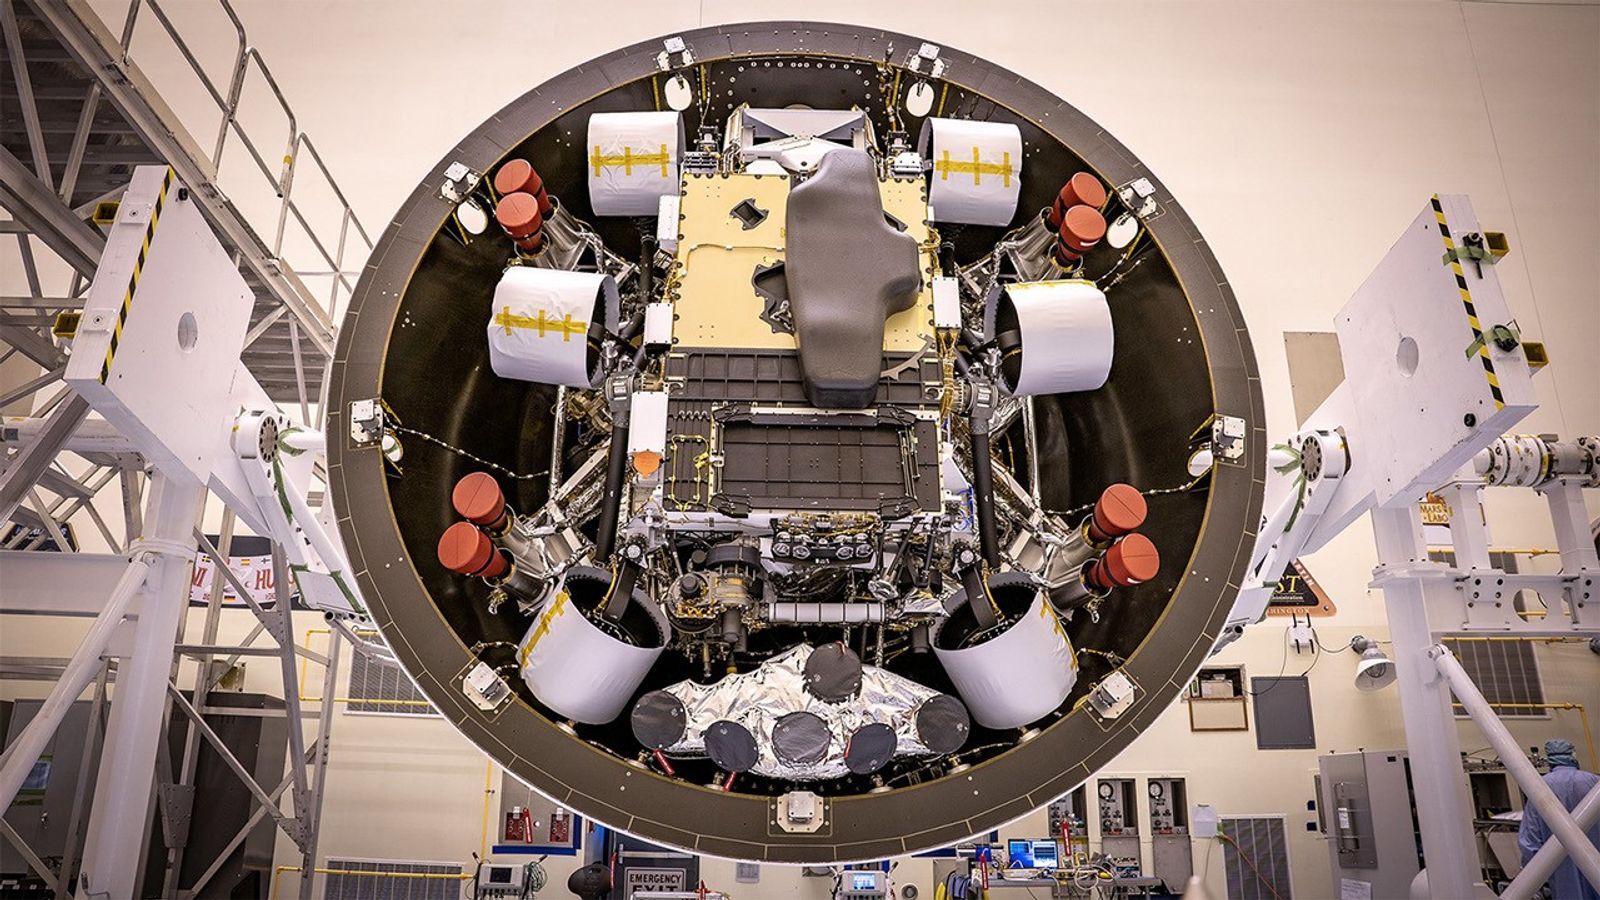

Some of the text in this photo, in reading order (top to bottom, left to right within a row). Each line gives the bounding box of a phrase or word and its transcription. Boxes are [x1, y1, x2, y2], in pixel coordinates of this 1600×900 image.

[1420, 504, 1443, 514] MARS
[1427, 512, 1449, 523] LABO
[629, 873, 682, 884] EMERGENCY
